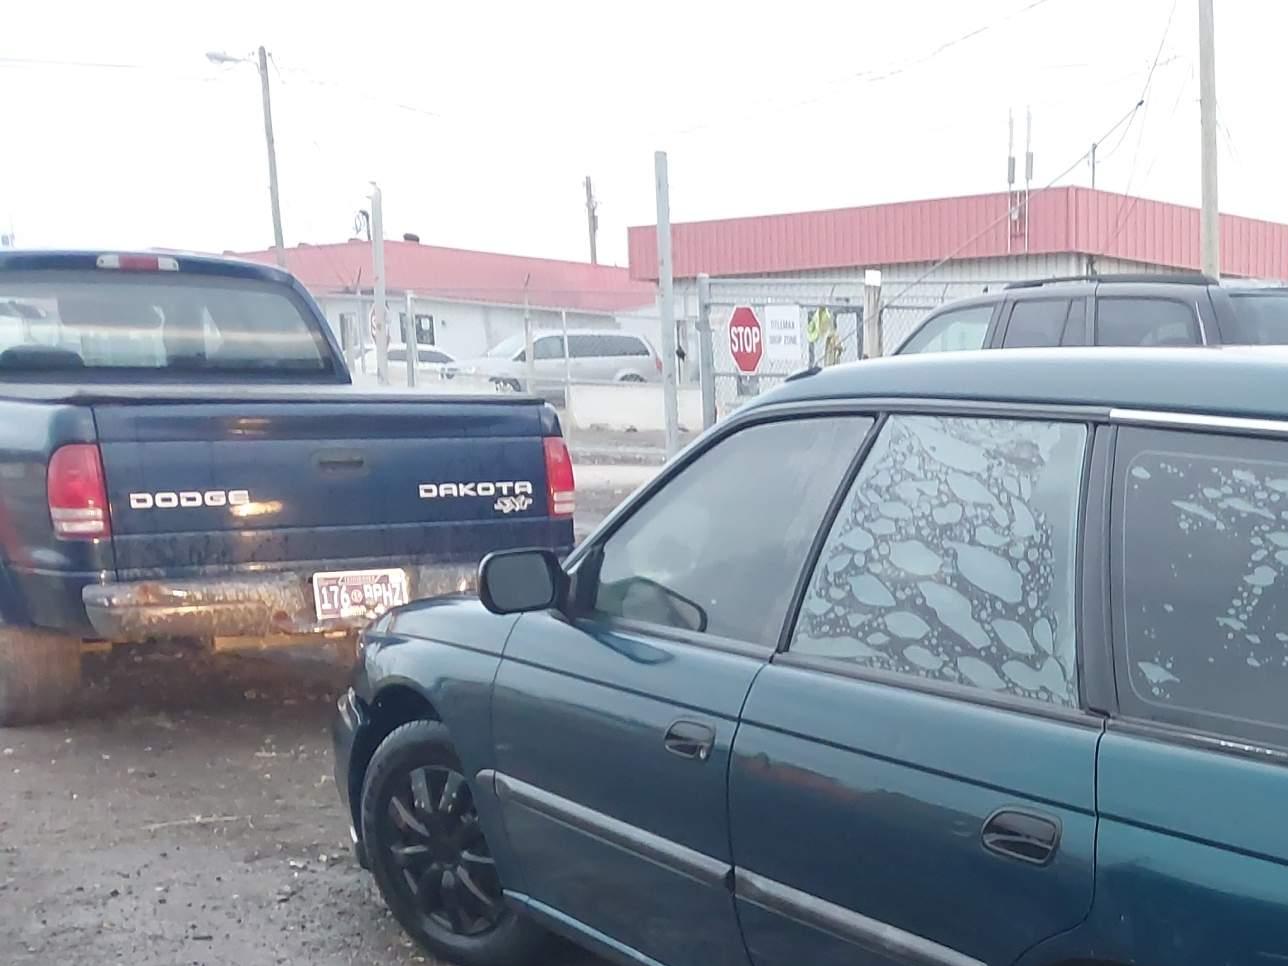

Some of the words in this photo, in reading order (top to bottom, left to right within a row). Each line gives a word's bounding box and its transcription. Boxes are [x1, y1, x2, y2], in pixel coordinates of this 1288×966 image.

[731, 326, 760, 353] STOP
[129, 489, 250, 509] DODGE
[418, 481, 533, 499] DAKOTA
[321, 585, 351, 609] 176
